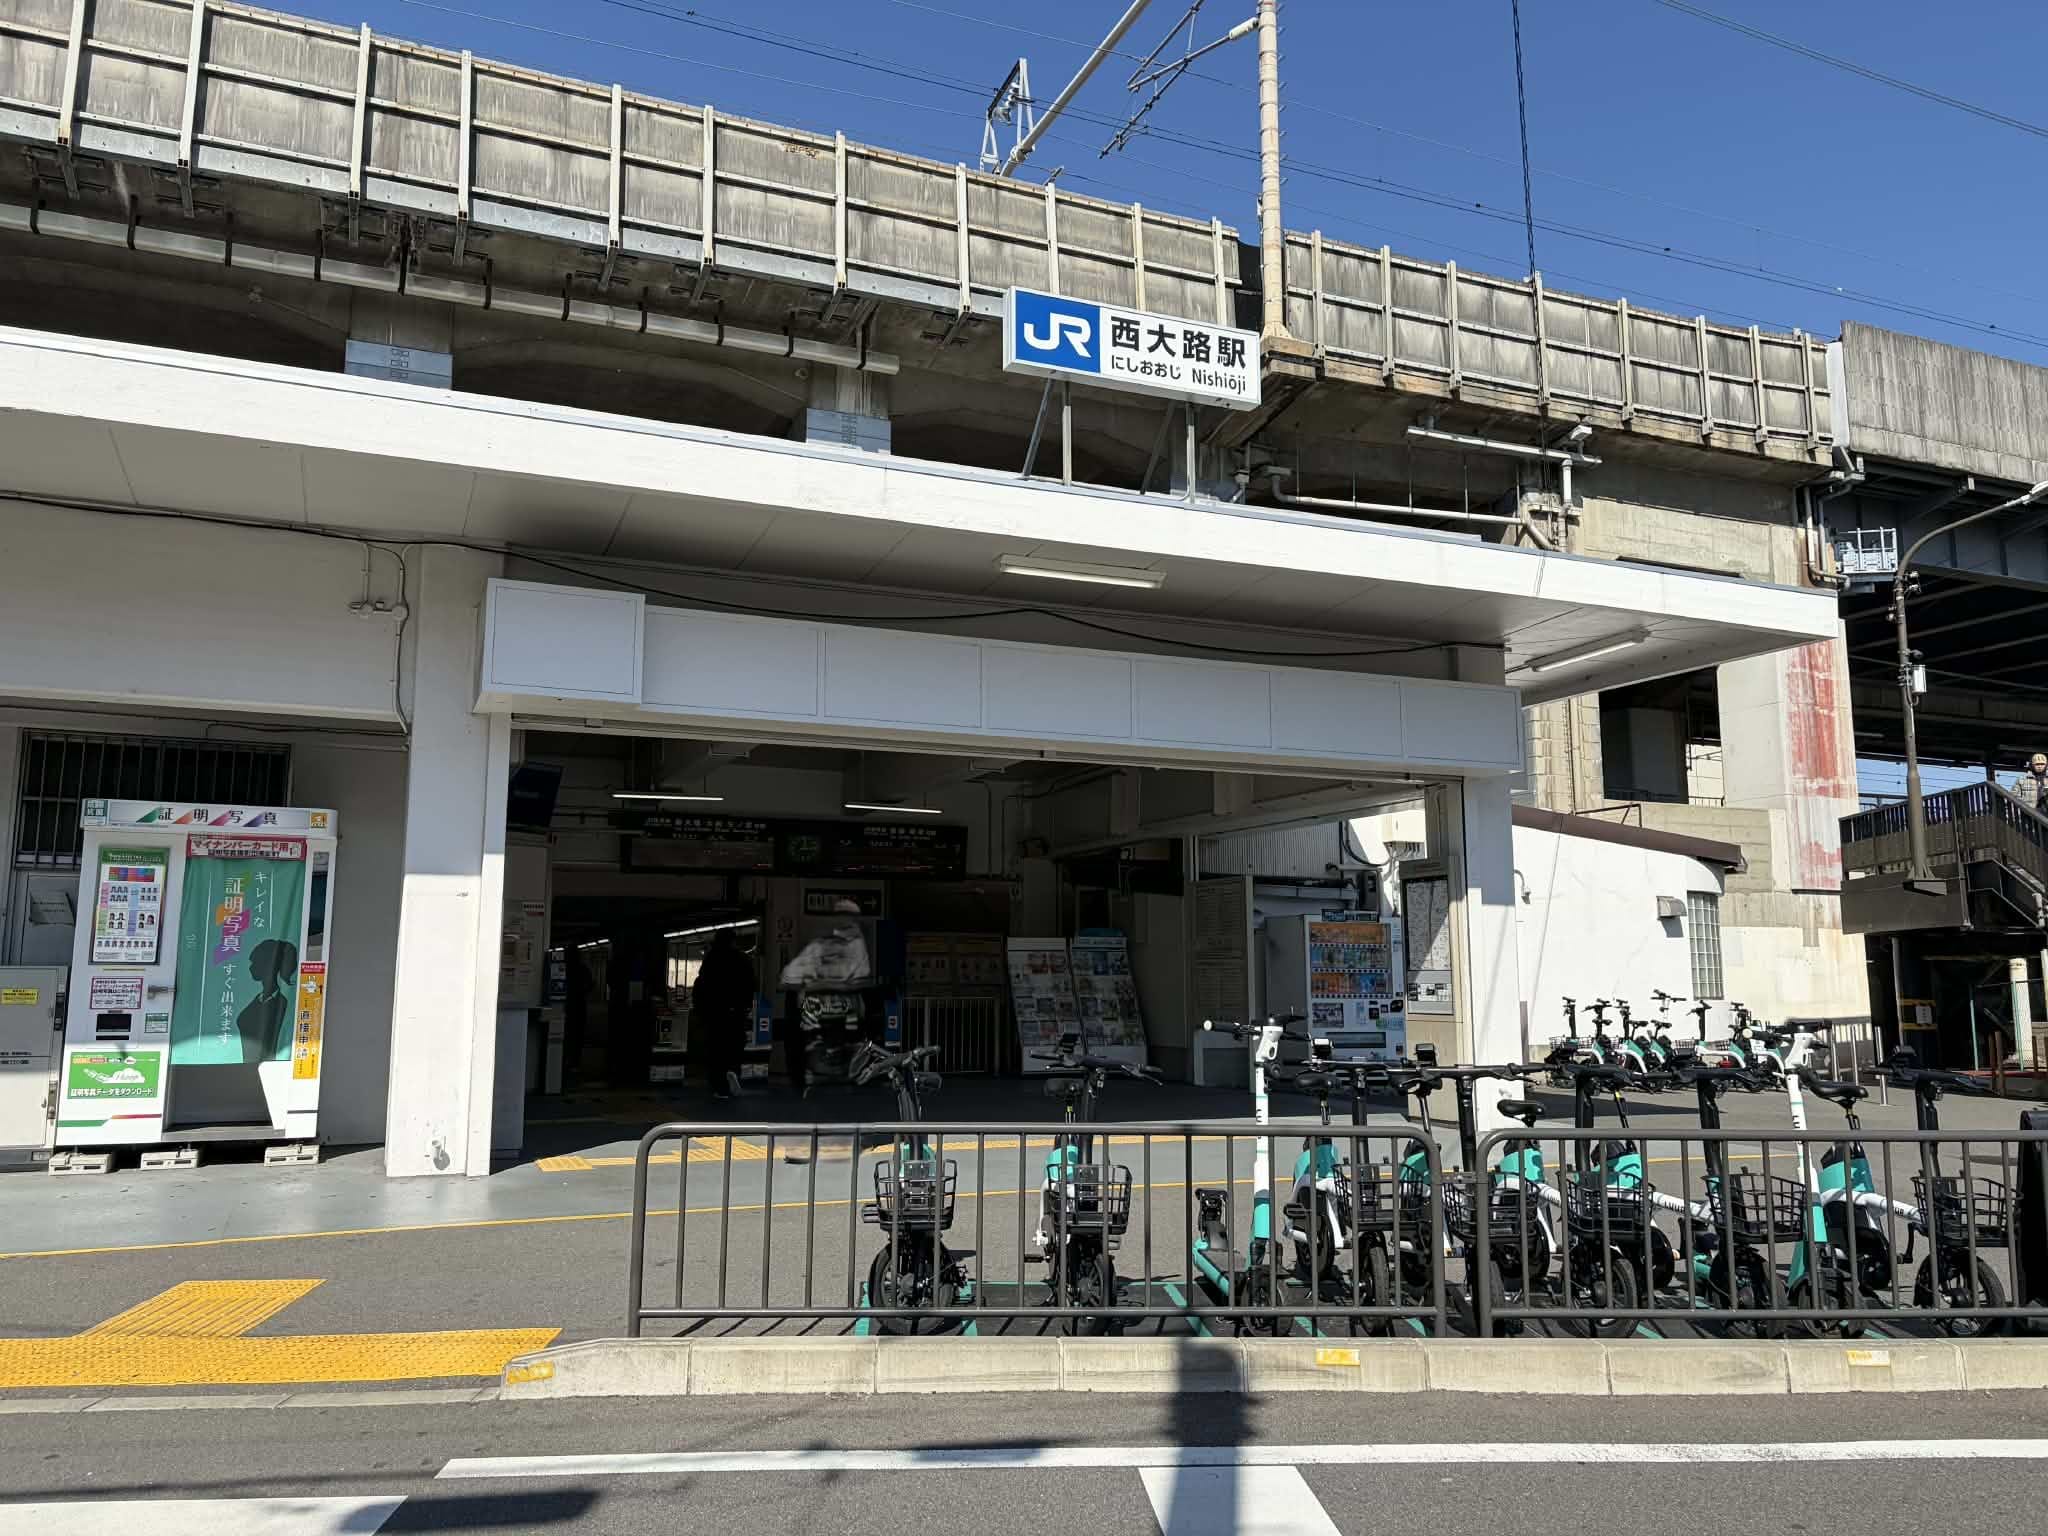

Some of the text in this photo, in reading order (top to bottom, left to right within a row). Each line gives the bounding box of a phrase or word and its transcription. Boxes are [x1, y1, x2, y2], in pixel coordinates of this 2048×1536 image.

[1023, 312, 1091, 358] JR
[1110, 316, 1246, 369] 西大路駅
[1111, 354, 1182, 380] にしおおじ
[1192, 368, 1246, 393] Nishiōji
[158, 808, 279, 825] 証明写真
[253, 871, 268, 928] キレイな
[218, 877, 244, 1046] 証明写真 すぐ出来ます
